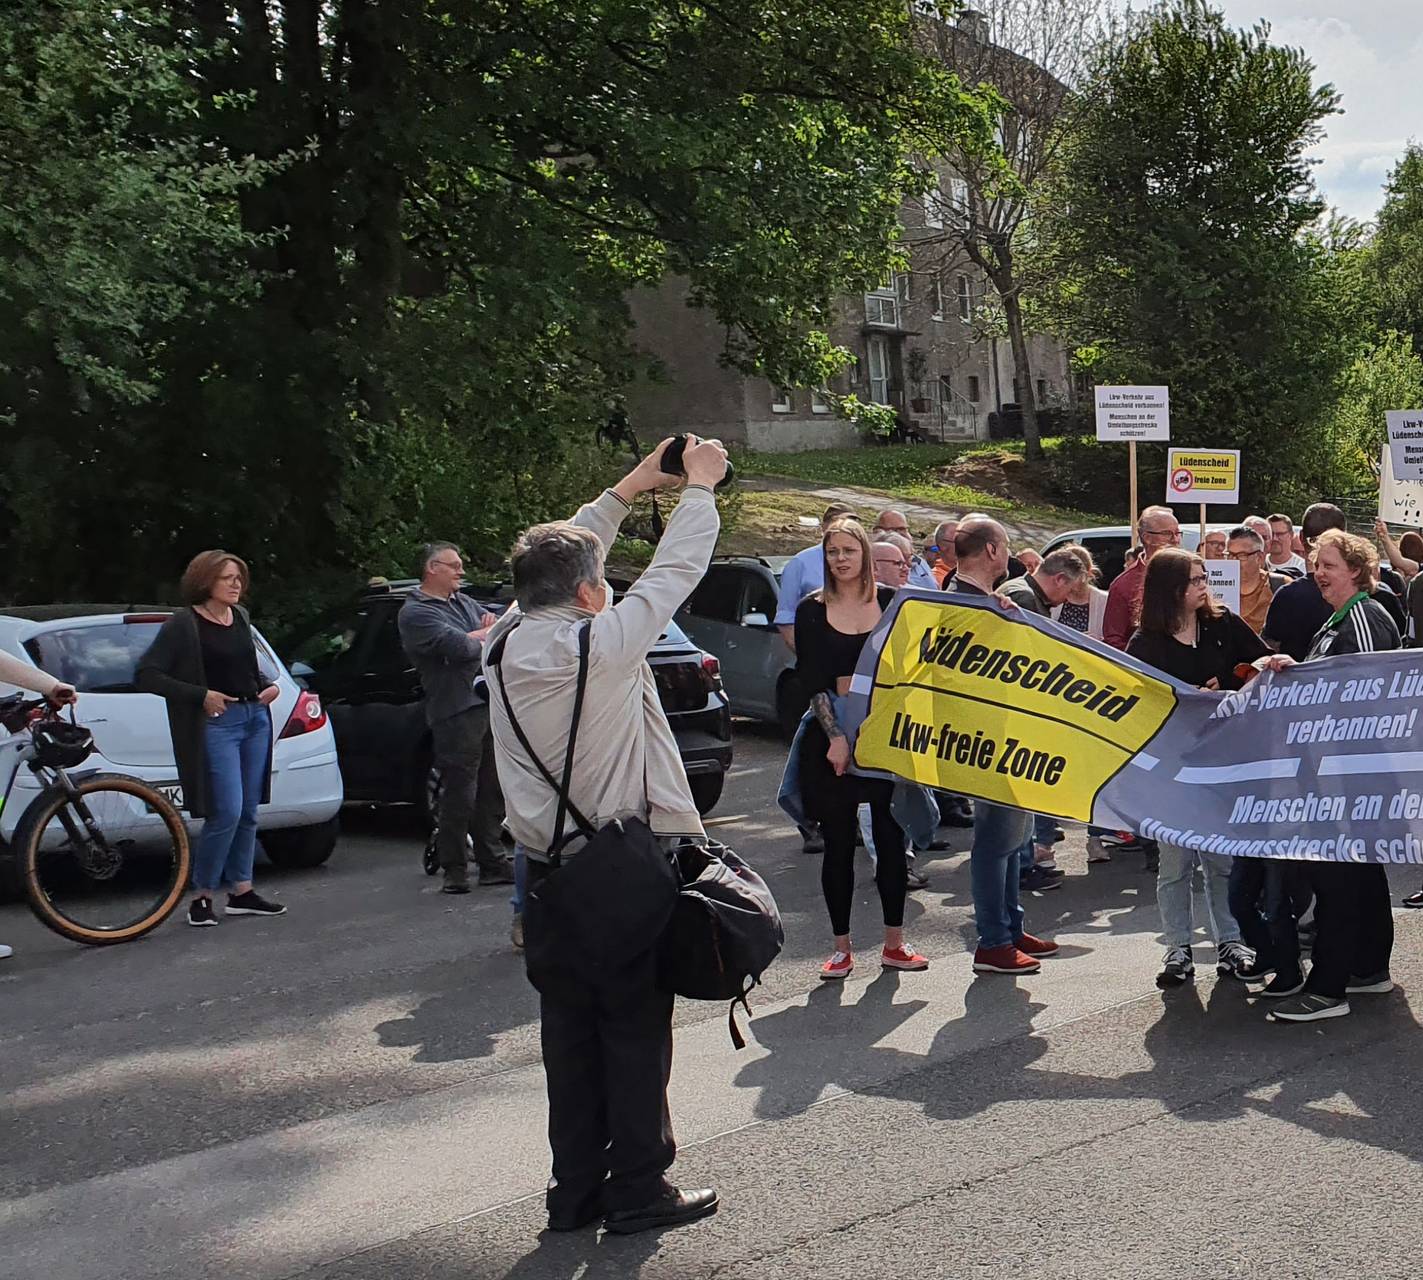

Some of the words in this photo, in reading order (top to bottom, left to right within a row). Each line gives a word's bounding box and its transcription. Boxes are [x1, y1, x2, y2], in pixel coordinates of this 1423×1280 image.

[1179, 456, 1230, 468] Lüdenscheid
[1210, 476, 1227, 485] Zone
[1208, 578, 1236, 587] bannen!
[1210, 569, 1223, 577] aus
[918, 627, 1141, 723] Lüdenscheid
[1340, 676, 1386, 702] aus
[1285, 708, 1419, 746] verbannen!
[888, 712, 997, 768] Lkw-freie
[994, 738, 1067, 786] Zone
[1228, 791, 1348, 824] Menschen
[1350, 794, 1384, 821] an
